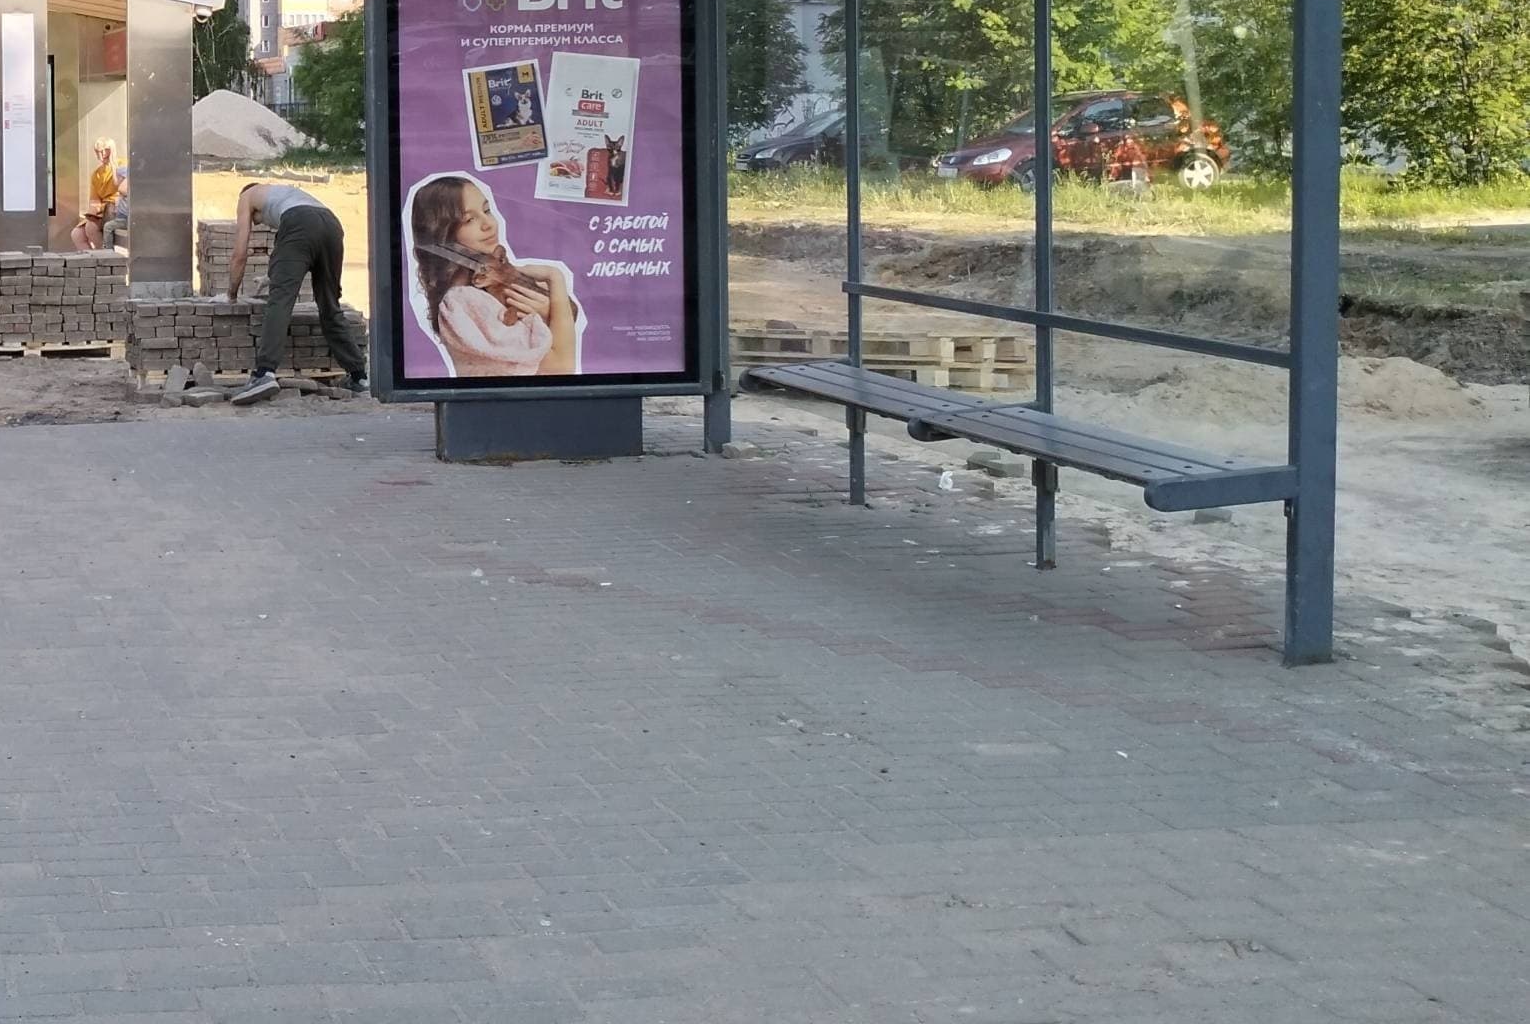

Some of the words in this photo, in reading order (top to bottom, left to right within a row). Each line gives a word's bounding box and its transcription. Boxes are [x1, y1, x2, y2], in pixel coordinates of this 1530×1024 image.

[490, 24, 532, 34] КОРМА
[534, 23, 594, 33] ПРЕМИУМ
[461, 39, 470, 47] И
[472, 36, 571, 48] СУПЕРПРЕМИУМ
[574, 35, 623, 44] КЛАССА
[488, 78, 511, 88] Brit
[581, 89, 603, 100] Brit
[581, 102, 602, 111] care
[576, 119, 604, 127] ADULT
[589, 216, 600, 231] С
[602, 212, 669, 234] ЗАБОТОЙ
[594, 240, 605, 253] О
[609, 238, 666, 253] САМЫХ
[587, 261, 671, 276] ЛЮБИМЫХ
